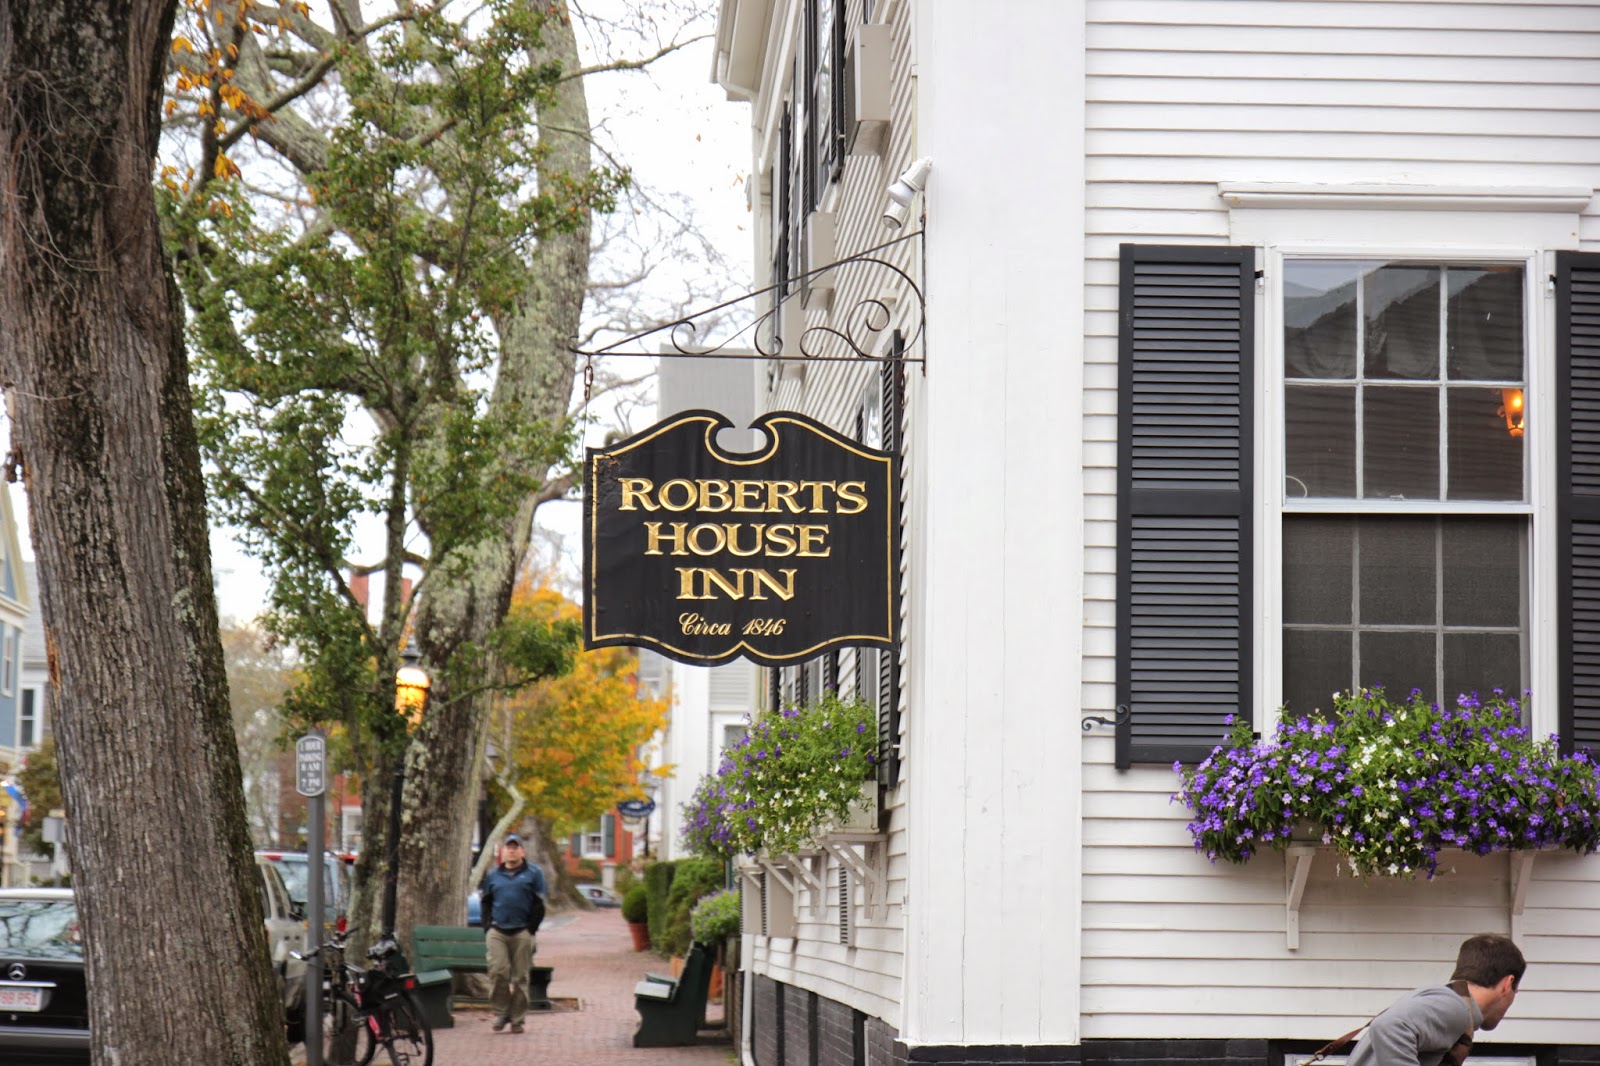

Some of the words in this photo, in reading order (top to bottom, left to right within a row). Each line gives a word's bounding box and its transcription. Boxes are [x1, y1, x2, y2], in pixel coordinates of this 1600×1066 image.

[618, 477, 868, 515] ROBERTS
[644, 521, 831, 558] HOUSE
[675, 567, 798, 602] INN
[679, 612, 731, 636] Circa
[742, 618, 786, 636] 1846
[299, 752, 321, 762] PARKING
